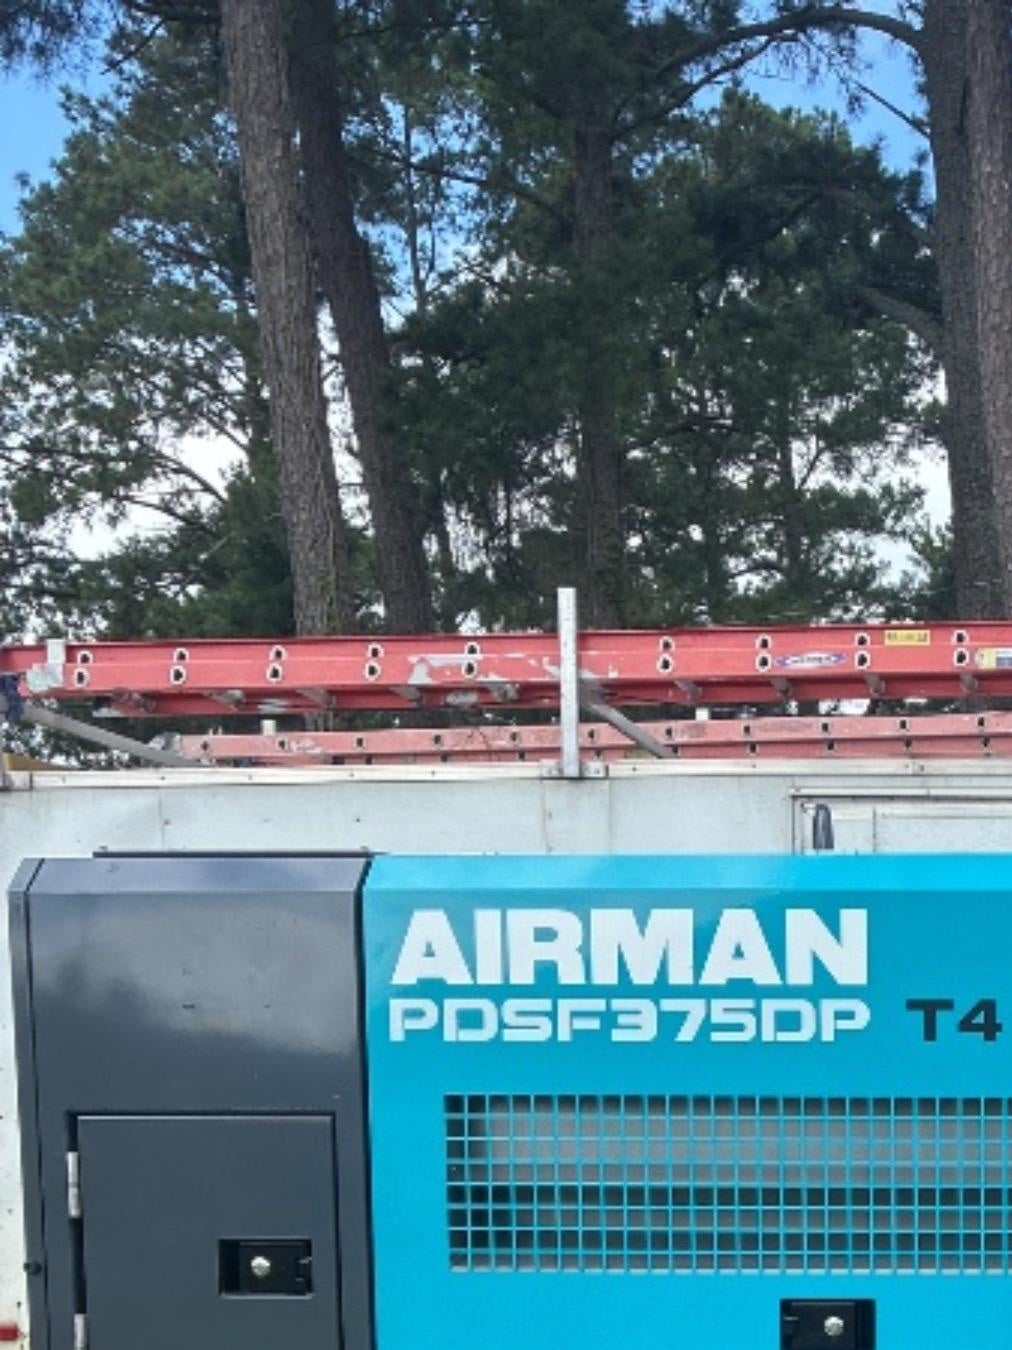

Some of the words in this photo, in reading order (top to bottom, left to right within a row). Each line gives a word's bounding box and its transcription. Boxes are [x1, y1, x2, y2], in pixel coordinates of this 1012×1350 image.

[390, 908, 868, 986] AIRMAN
[389, 997, 870, 1043] PDSF375DP
[905, 998, 1003, 1043] T4
